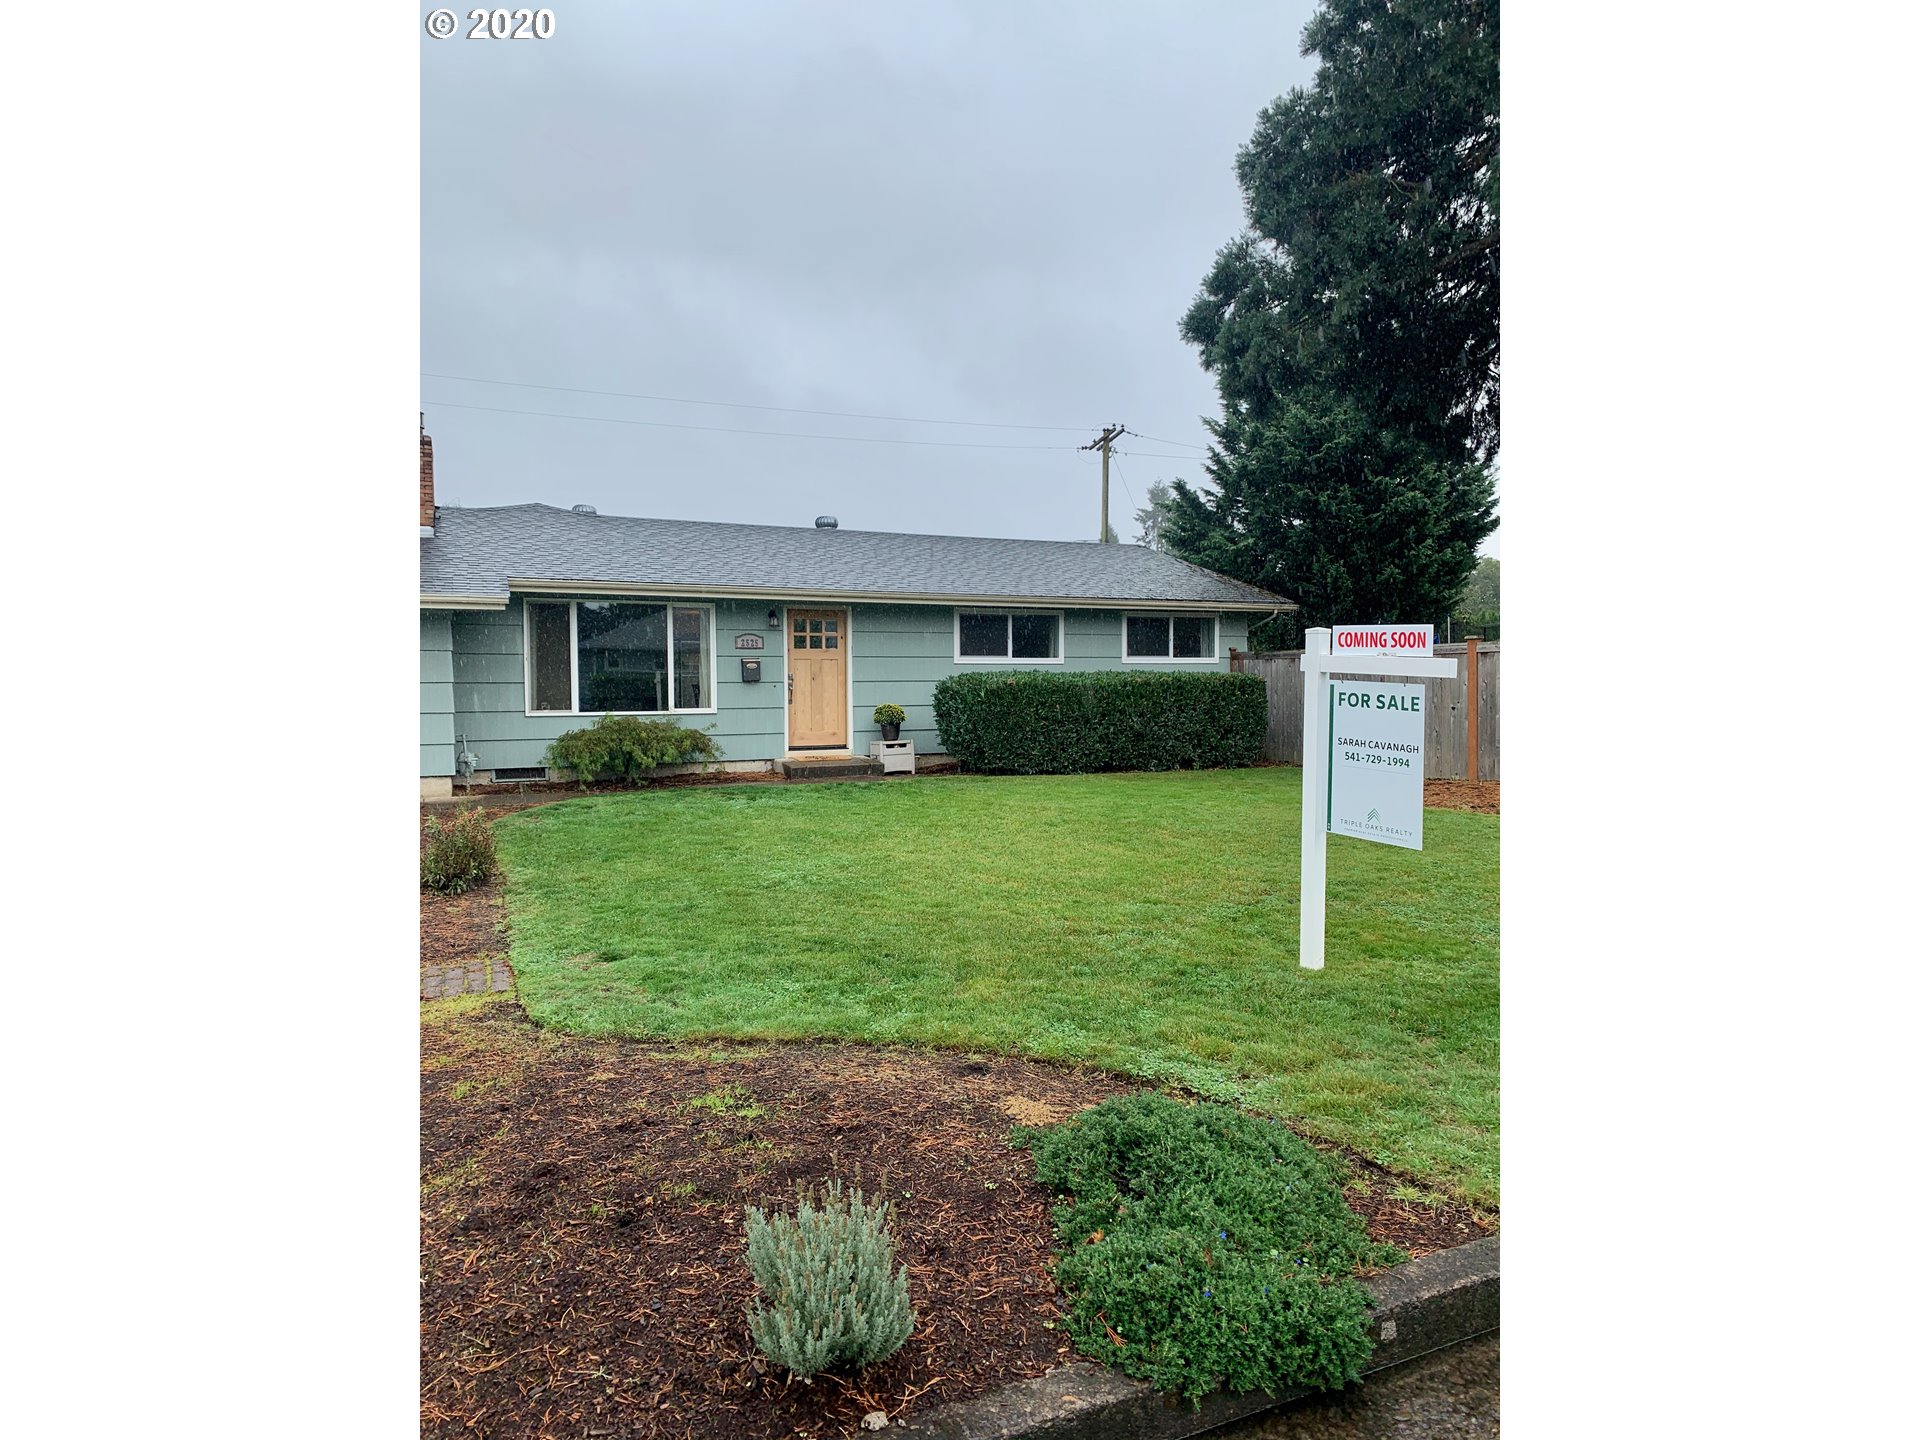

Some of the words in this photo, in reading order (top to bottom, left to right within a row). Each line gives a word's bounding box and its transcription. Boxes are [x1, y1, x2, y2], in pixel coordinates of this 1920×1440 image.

[1338, 631, 1387, 648] COMING
[1391, 631, 1426, 648] SOON
[1338, 692, 1371, 709] FOR
[1376, 694, 1420, 712] SALE
[1337, 737, 1366, 748] SARAH
[1368, 740, 1419, 754] CAVANAGH
[1344, 751, 1410, 768] 541-729-1994
[1340, 818, 1362, 828] TRIPLE
[1364, 823, 1383, 832] OAKS
[1386, 827, 1413, 837] REALTY
